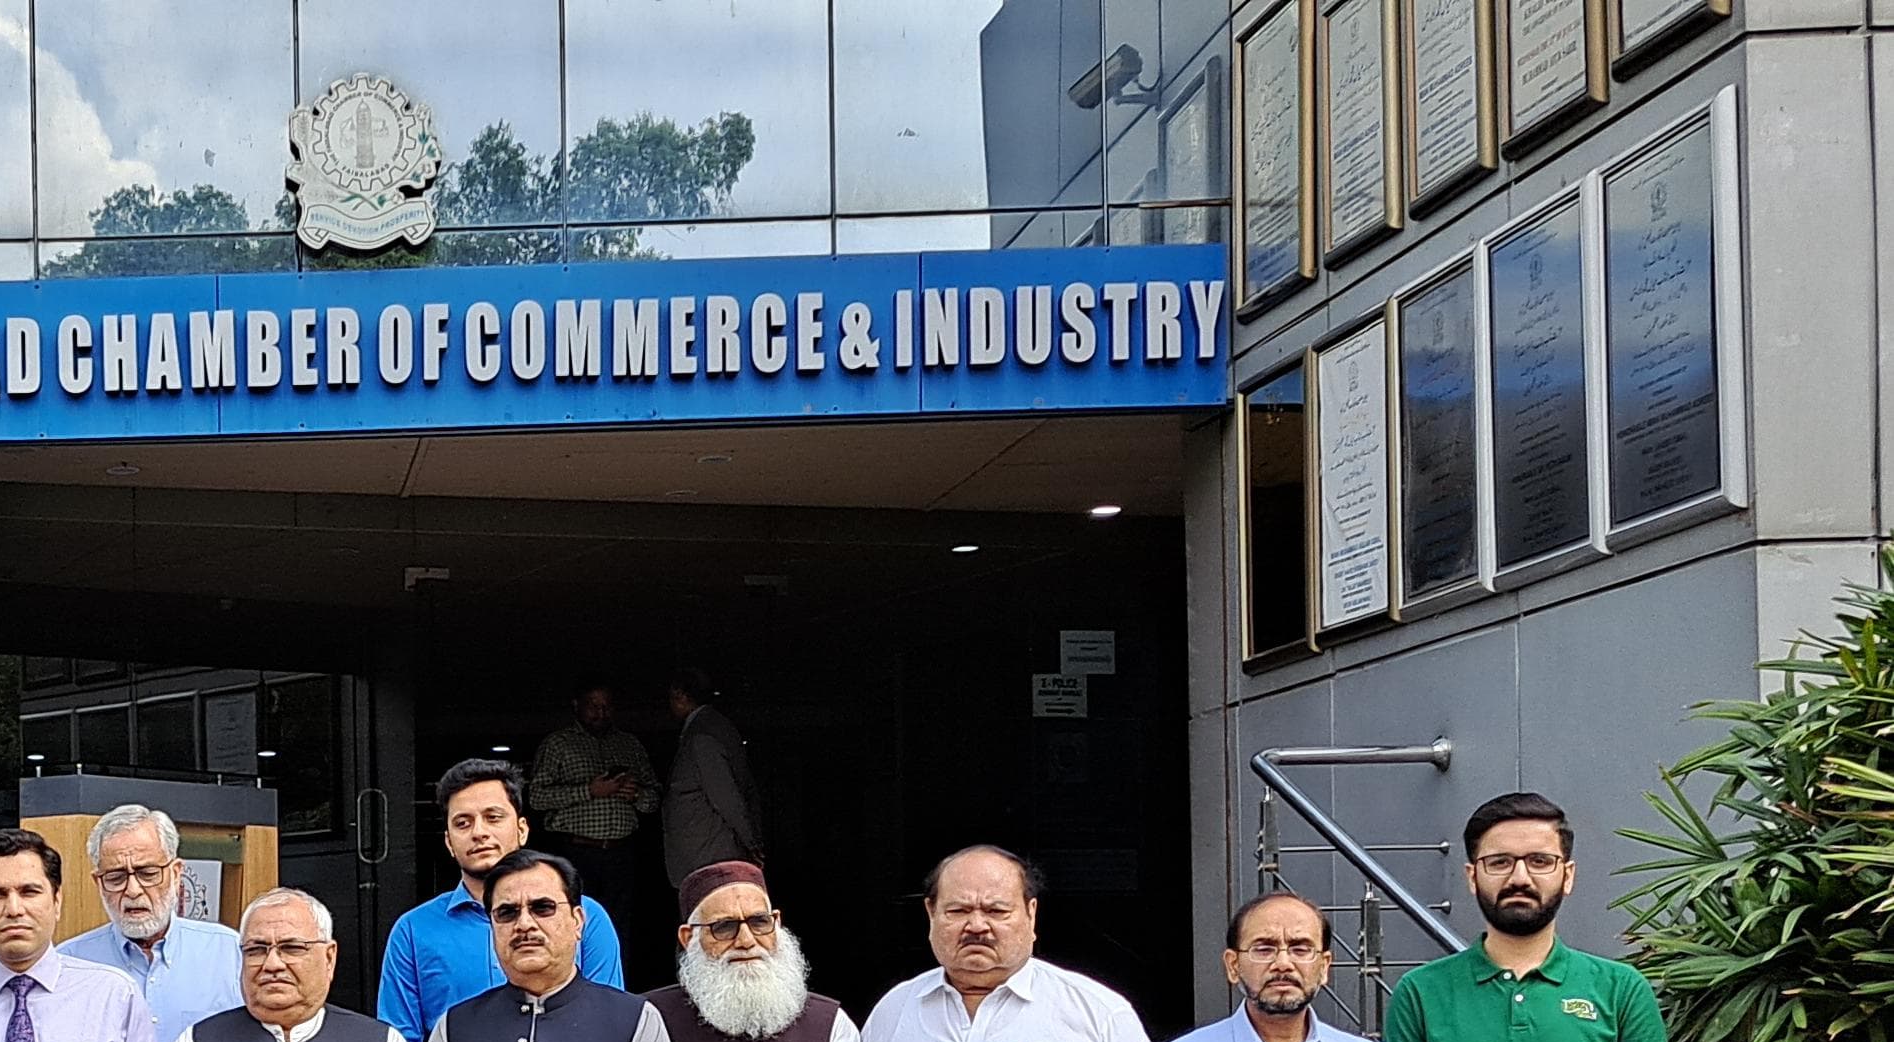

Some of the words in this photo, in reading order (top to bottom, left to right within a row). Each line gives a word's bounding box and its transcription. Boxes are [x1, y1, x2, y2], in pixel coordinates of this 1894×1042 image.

[341, 163, 390, 178] FAISALABAD
[310, 212, 341, 227] SERVICE
[342, 222, 379, 234] DEVOTION
[380, 210, 425, 230] PROSPERITY
[57, 307, 362, 395] CHAMBER
[378, 303, 450, 385] OF
[464, 293, 826, 383] COMMERCE
[838, 302, 881, 370] &
[895, 281, 1225, 368] INDUSTRY
